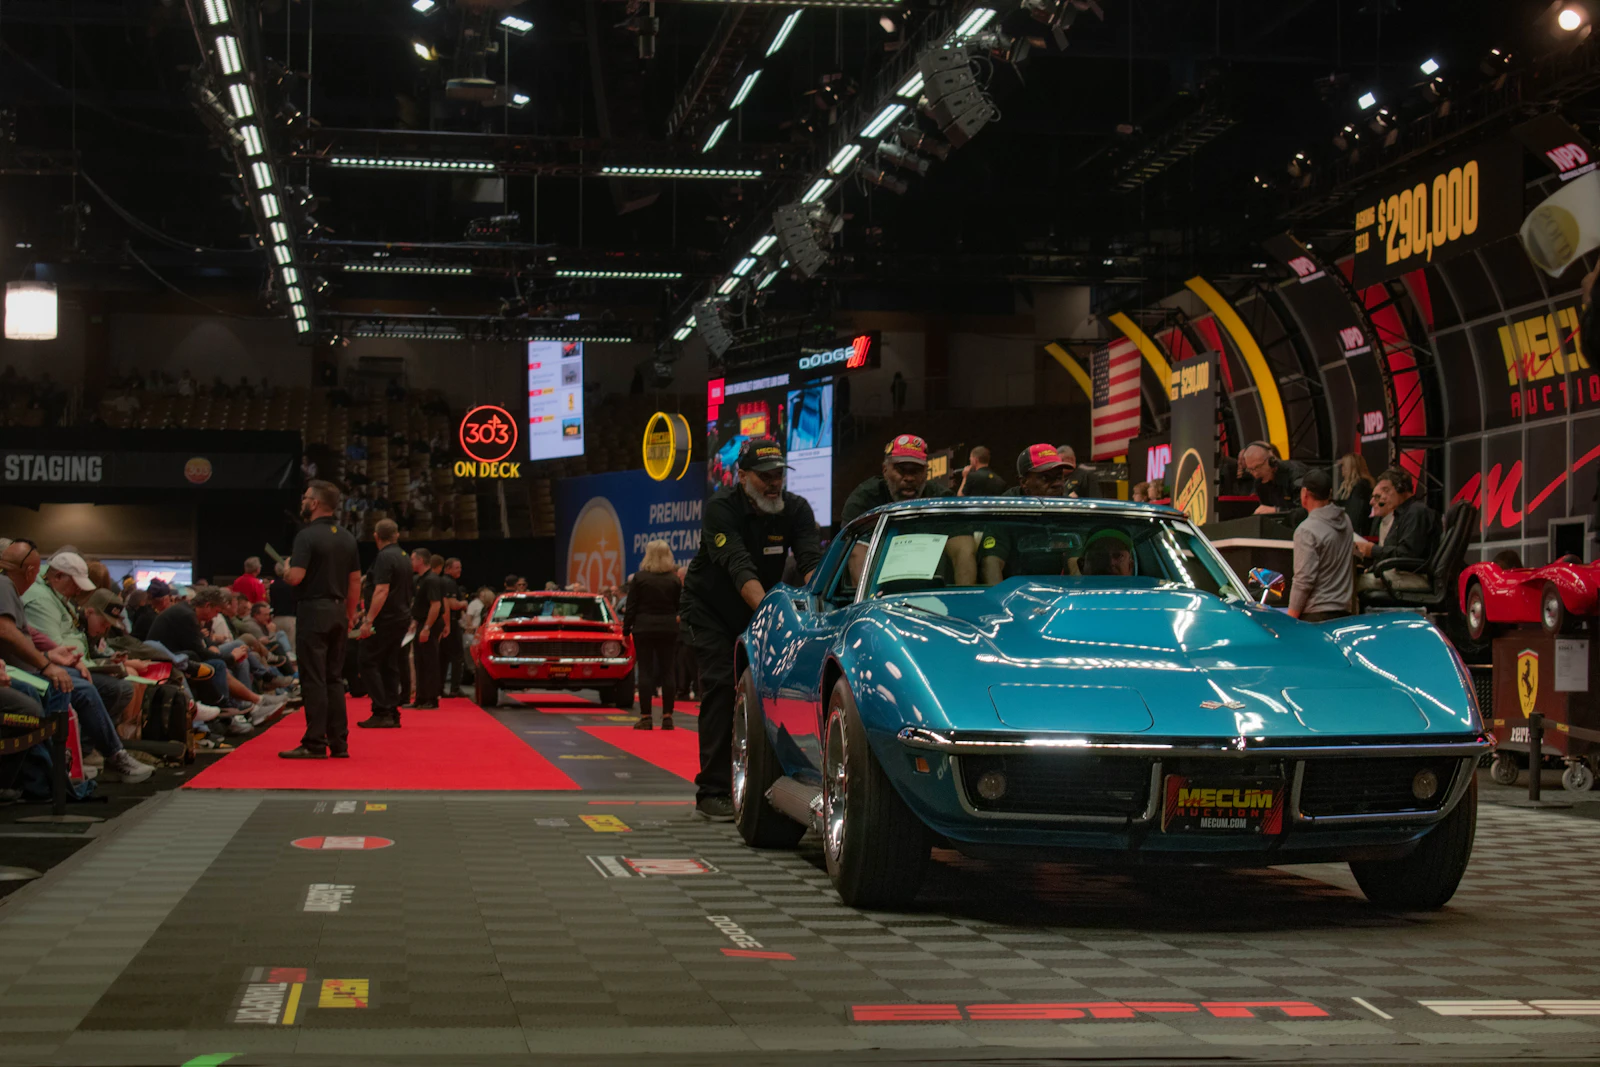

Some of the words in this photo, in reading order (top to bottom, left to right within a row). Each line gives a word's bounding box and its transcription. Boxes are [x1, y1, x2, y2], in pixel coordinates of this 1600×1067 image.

[1546, 142, 1589, 172] NPD
[1378, 160, 1478, 265] $290,000
[1288, 256, 1317, 277] NPD
[1340, 326, 1364, 350] NPD
[1498, 306, 1591, 386] MECU
[799, 346, 855, 369] DODGE
[465, 423, 509, 444] 303
[1363, 410, 1384, 435] NPD
[5, 454, 102, 481] STAGING
[454, 461, 476, 477] ON
[480, 462, 520, 478] DECK
[1146, 443, 1172, 483] NP
[649, 500, 703, 524] PREMIUM
[633, 529, 702, 554] PRECTAN
[573, 550, 618, 592] 303
[4, 713, 39, 724] MECUM
[1178, 788, 1273, 808] MECUM
[1177, 808, 1272, 817] AUCTIONS
[1200, 817, 1247, 829] MECUM.COM
[706, 915, 764, 949] DODGE
